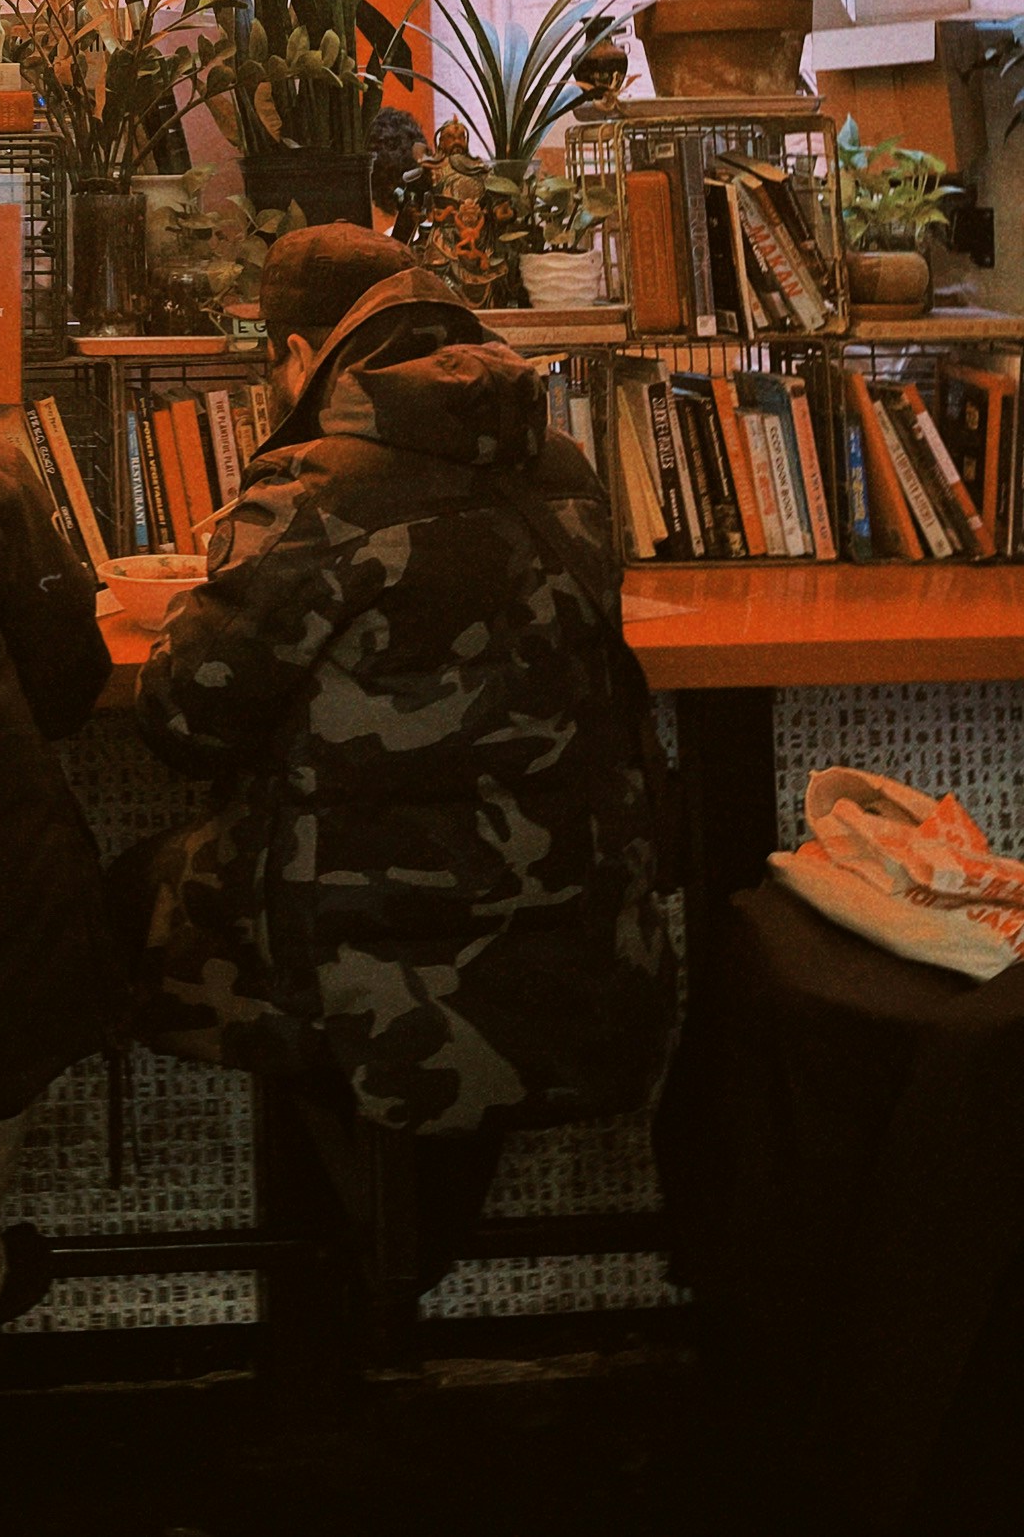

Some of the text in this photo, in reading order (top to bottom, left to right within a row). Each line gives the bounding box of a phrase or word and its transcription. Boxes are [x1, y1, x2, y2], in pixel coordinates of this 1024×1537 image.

[749, 224, 803, 299] MAKAN
[143, 421, 155, 458] POWER
[223, 456, 235, 477] PLATE
[130, 456, 146, 527] RESTAURANT
